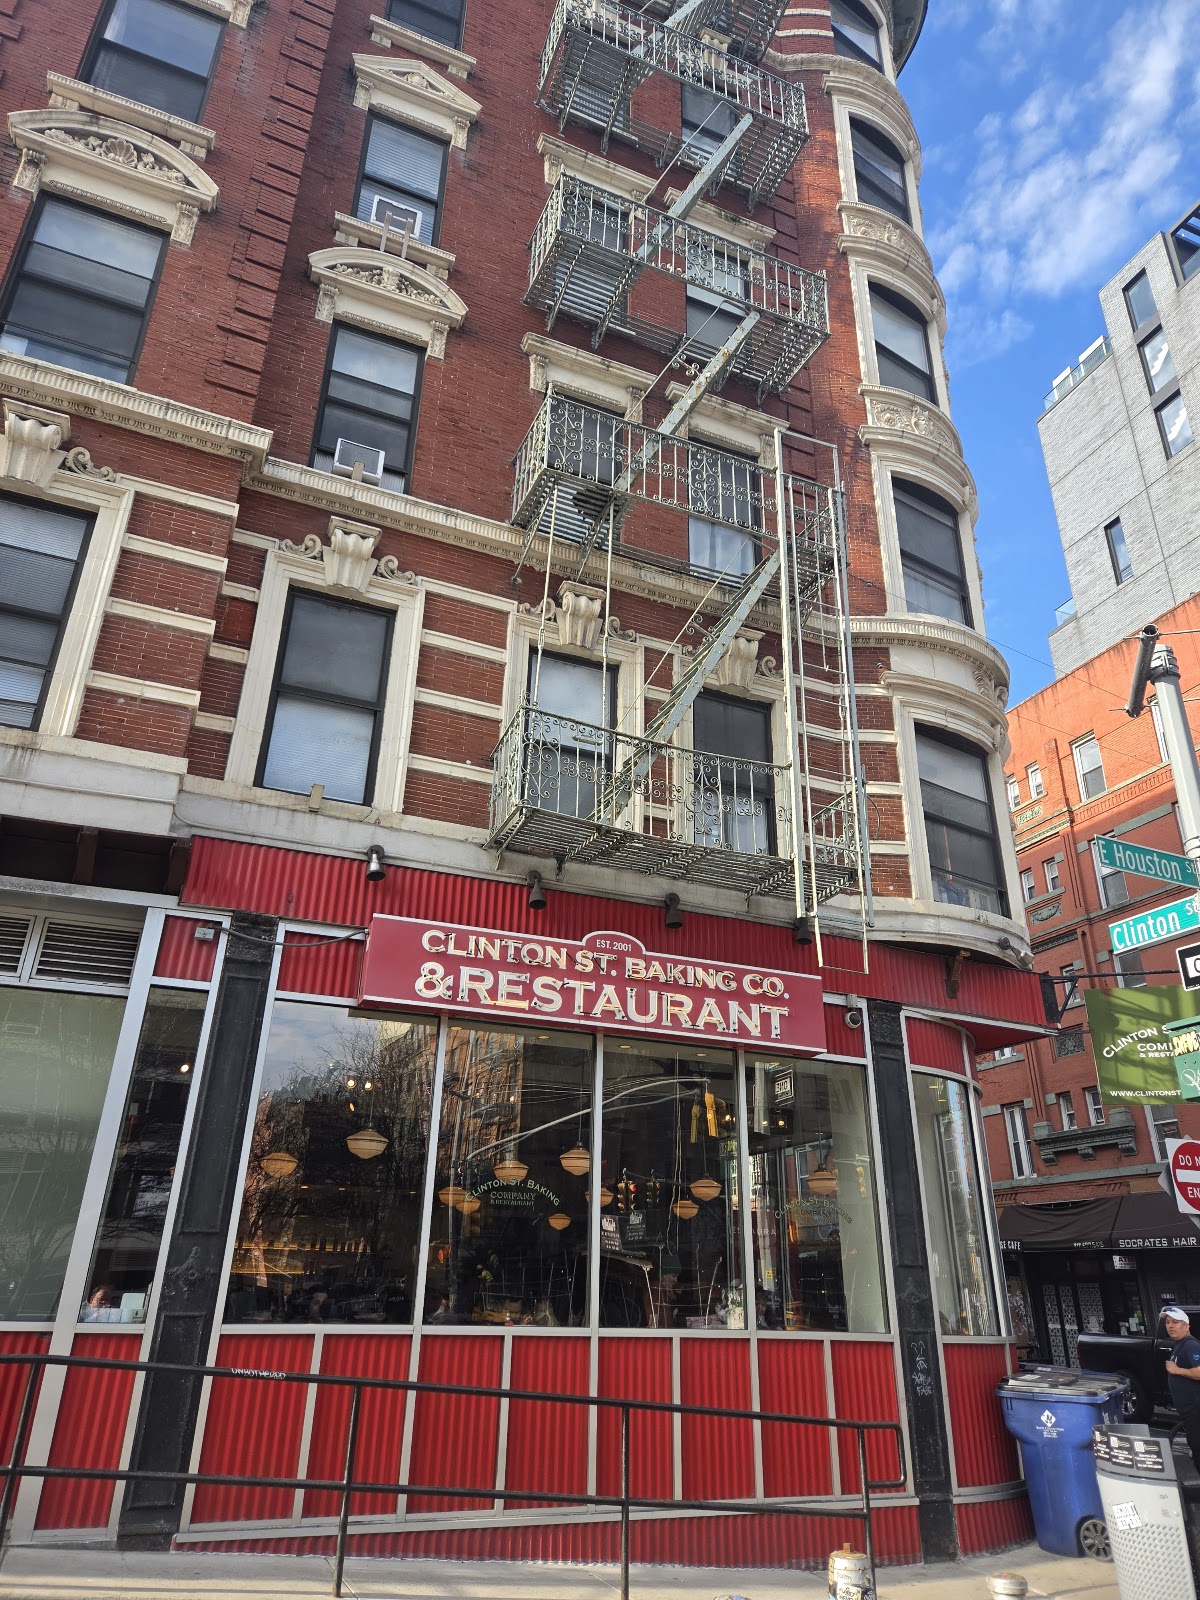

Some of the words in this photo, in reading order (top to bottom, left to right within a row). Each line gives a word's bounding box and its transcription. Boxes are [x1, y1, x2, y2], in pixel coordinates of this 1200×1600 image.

[1099, 840, 1109, 864] E
[1114, 844, 1182, 881] Houston
[1185, 861, 1197, 875] St
[1113, 910, 1181, 950] Clinton
[1186, 900, 1198, 915] St
[596, 939, 612, 949] EST.
[613, 941, 632, 951] 2001
[422, 929, 568, 970] CLINTON
[575, 951, 618, 977] ST.
[625, 957, 737, 992] BAKING
[743, 973, 790, 1000] CO.
[457, 965, 790, 1039] RESTAURANT
[1103, 1027, 1158, 1058] CLINTON
[1161, 1024, 1173, 1034] S
[1179, 1155, 1192, 1166] DO
[465, 1179, 507, 1202] CLINTON
[509, 1177, 524, 1186] ST.
[527, 1179, 560, 1206] BAKING
[490, 1191, 536, 1200] COMPANY
[1119, 1238, 1168, 1248] SOCRATES
[1173, 1237, 1197, 1246] HAIR
